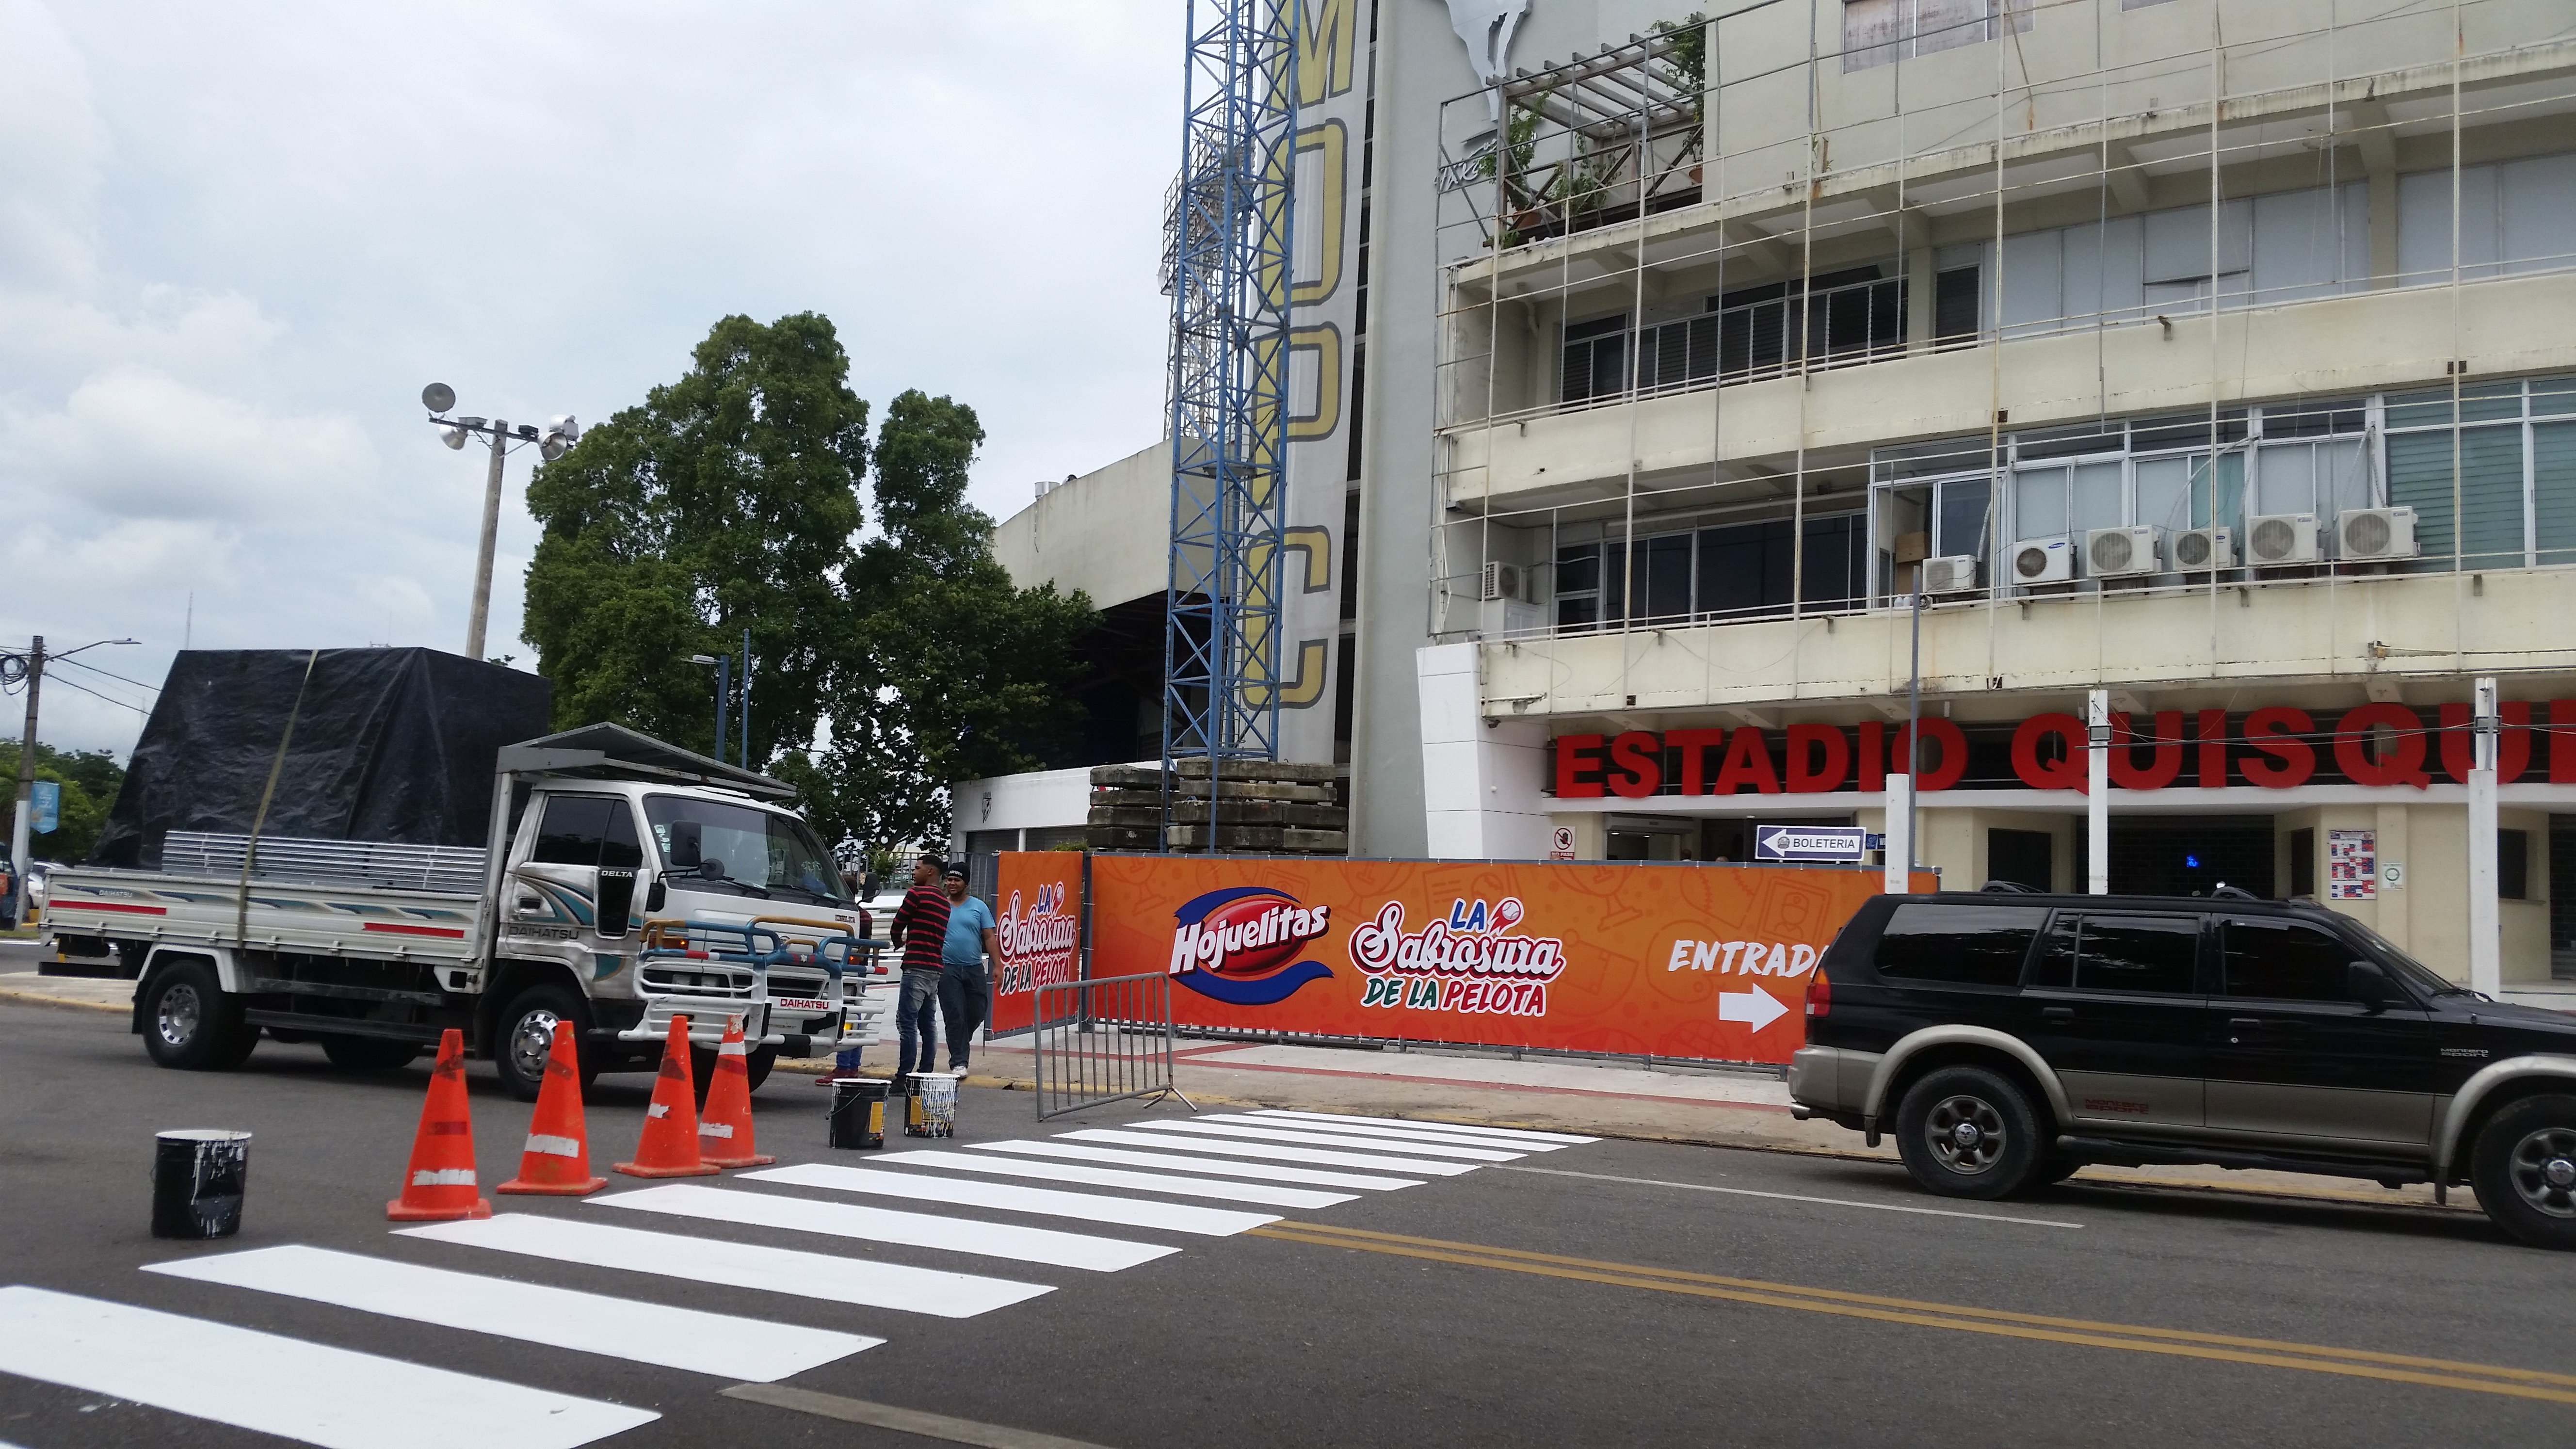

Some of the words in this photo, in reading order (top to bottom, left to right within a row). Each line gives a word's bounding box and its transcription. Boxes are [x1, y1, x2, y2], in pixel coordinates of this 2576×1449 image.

[1556, 717, 1969, 799] ESTADIO
[1793, 838, 1855, 849] BOLETERIA
[601, 869, 633, 878] DELTA
[99, 889, 133, 898] DAIHATSU
[1037, 885, 1052, 915] LA
[998, 892, 1076, 960] Sabrosura
[1450, 900, 1485, 931] LA
[508, 926, 579, 940] DAIHATSU
[1169, 905, 1331, 976] Hojuelitas
[1353, 903, 1564, 977] Sabrosura
[1001, 966, 1018, 995] DE
[1020, 962, 1032, 991] LA
[1033, 956, 1069, 989] PELOTA
[780, 998, 829, 1010] DAIHATSU
[1363, 977, 1405, 1005] DE
[1408, 980, 1437, 1008] LA
[1443, 981, 1544, 1015] PELOTA
